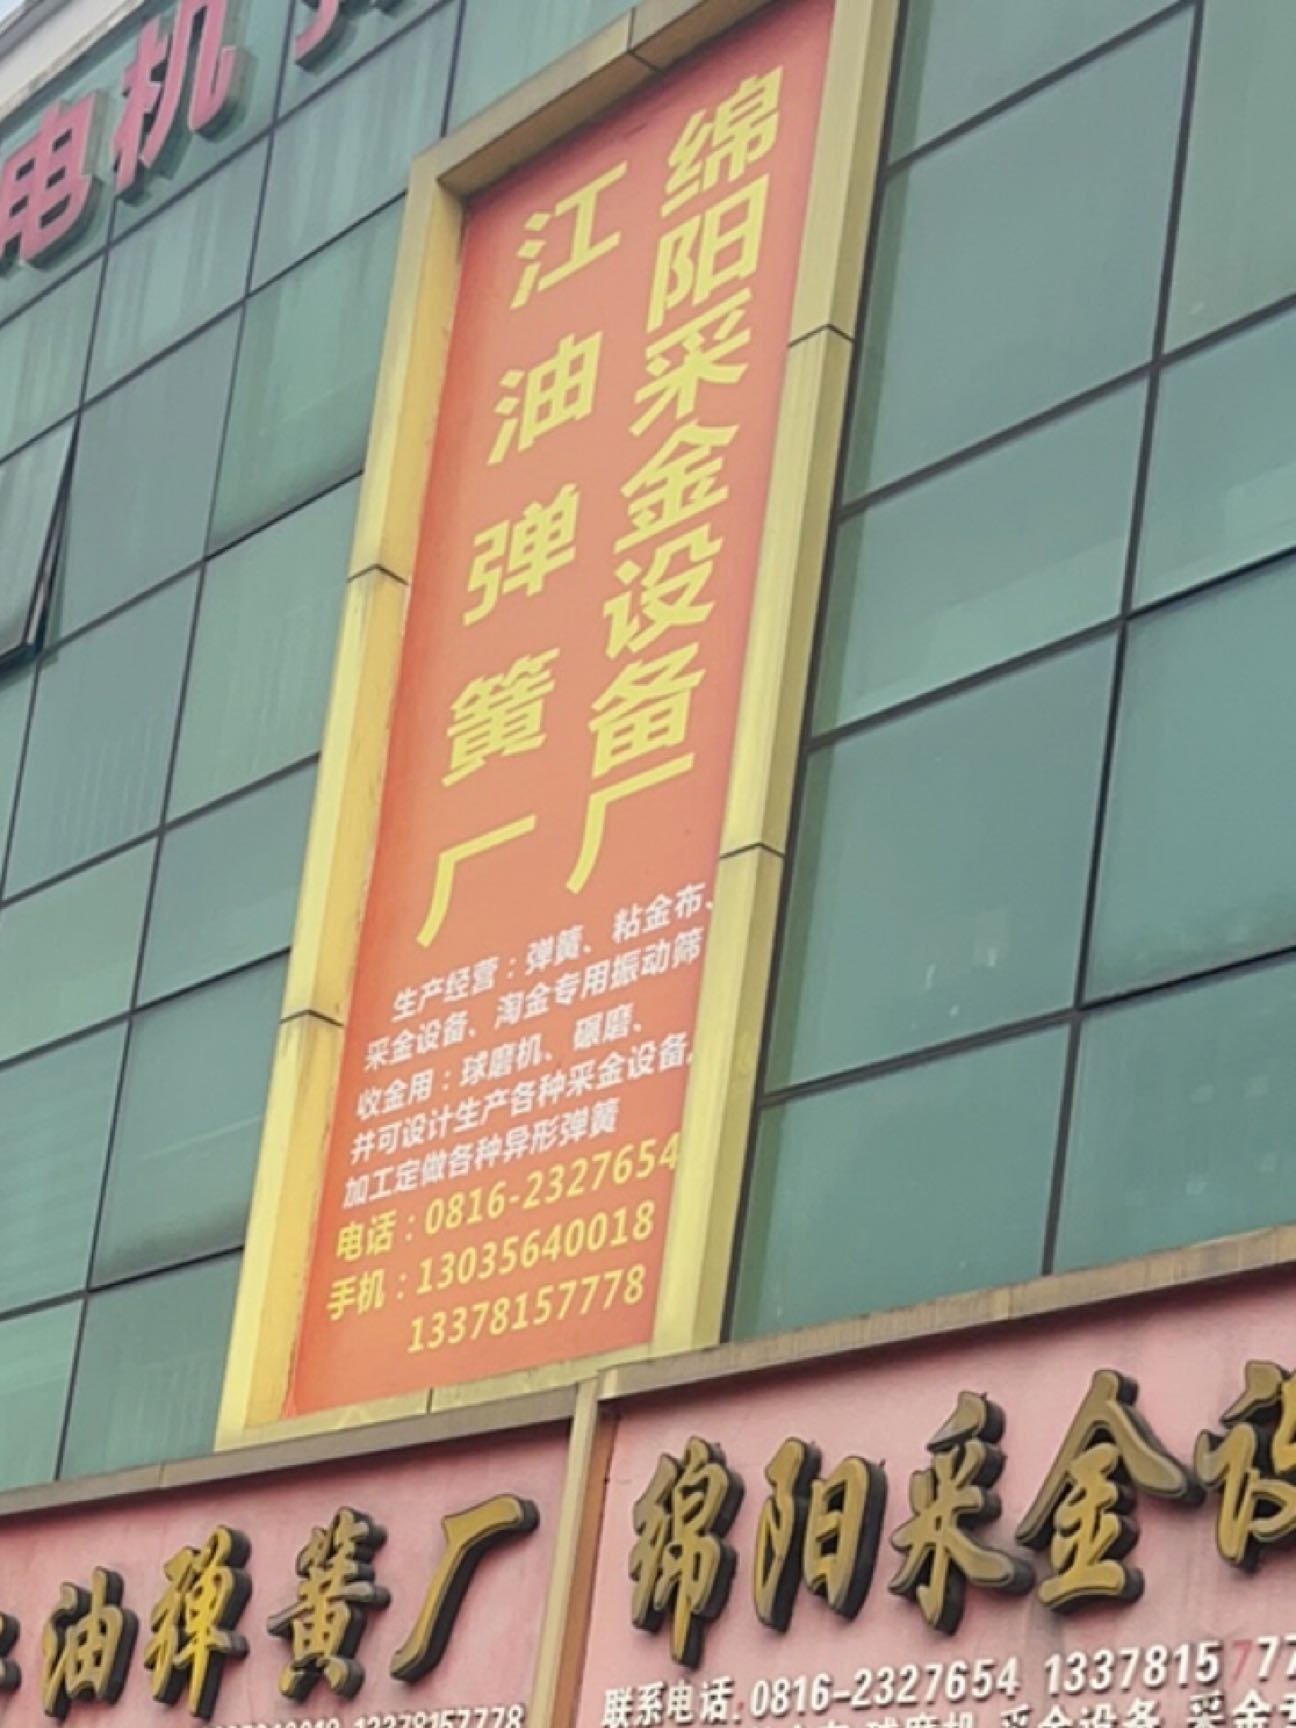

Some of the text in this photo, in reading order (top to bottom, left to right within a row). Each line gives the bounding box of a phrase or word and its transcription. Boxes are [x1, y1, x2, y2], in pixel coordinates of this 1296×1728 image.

[416, 162, 627, 948] 江油弹簧厂
[566, 66, 783, 893] 绵阳采金设备厂
[342, 1099, 621, 1210] 加工定做各种异形弹簧
[407, 1264, 646, 1354] 13378157778
